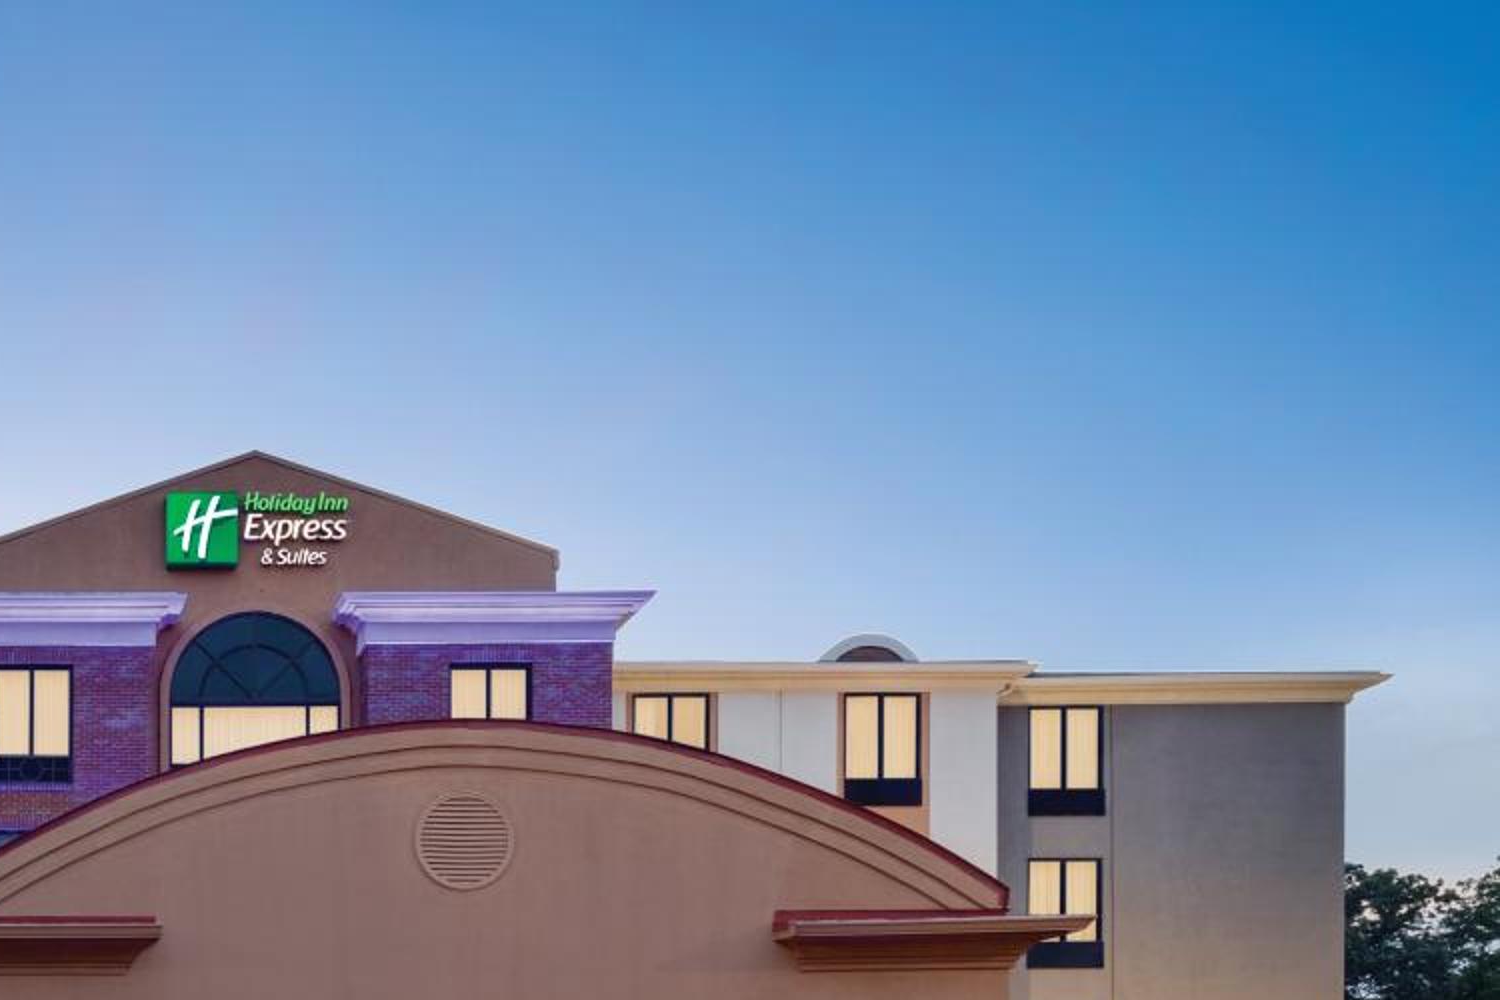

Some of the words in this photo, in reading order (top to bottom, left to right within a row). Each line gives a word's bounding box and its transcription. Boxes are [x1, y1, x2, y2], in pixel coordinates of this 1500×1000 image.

[244, 492, 317, 514] Holiday
[318, 492, 348, 511] Inn
[173, 495, 238, 558] H
[243, 513, 347, 546] Express
[261, 548, 273, 565] &
[276, 549, 328, 565] Suites
